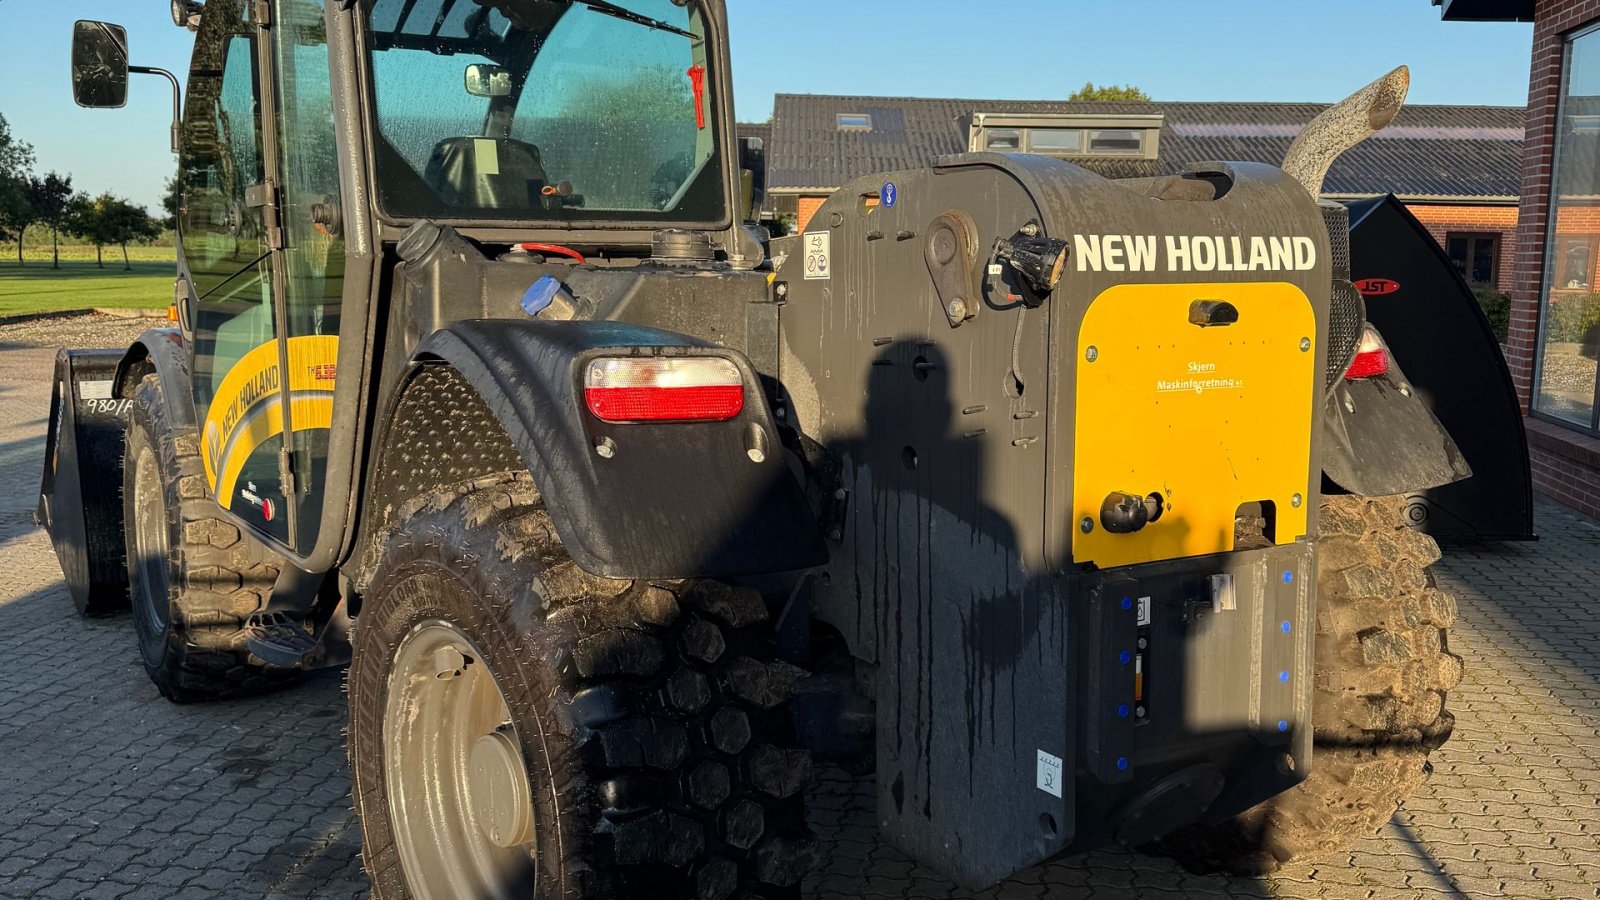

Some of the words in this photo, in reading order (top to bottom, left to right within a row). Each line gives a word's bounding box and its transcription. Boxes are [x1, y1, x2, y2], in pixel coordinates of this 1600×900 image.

[1074, 234, 1157, 272] NEW
[1165, 235, 1316, 272] HOLLAND
[1361, 280, 1388, 292] JST
[1187, 361, 1216, 373] Skjern
[1157, 378, 1234, 390] Maskinforretning
[222, 395, 238, 443] NEW
[240, 364, 279, 413] HOLLAND
